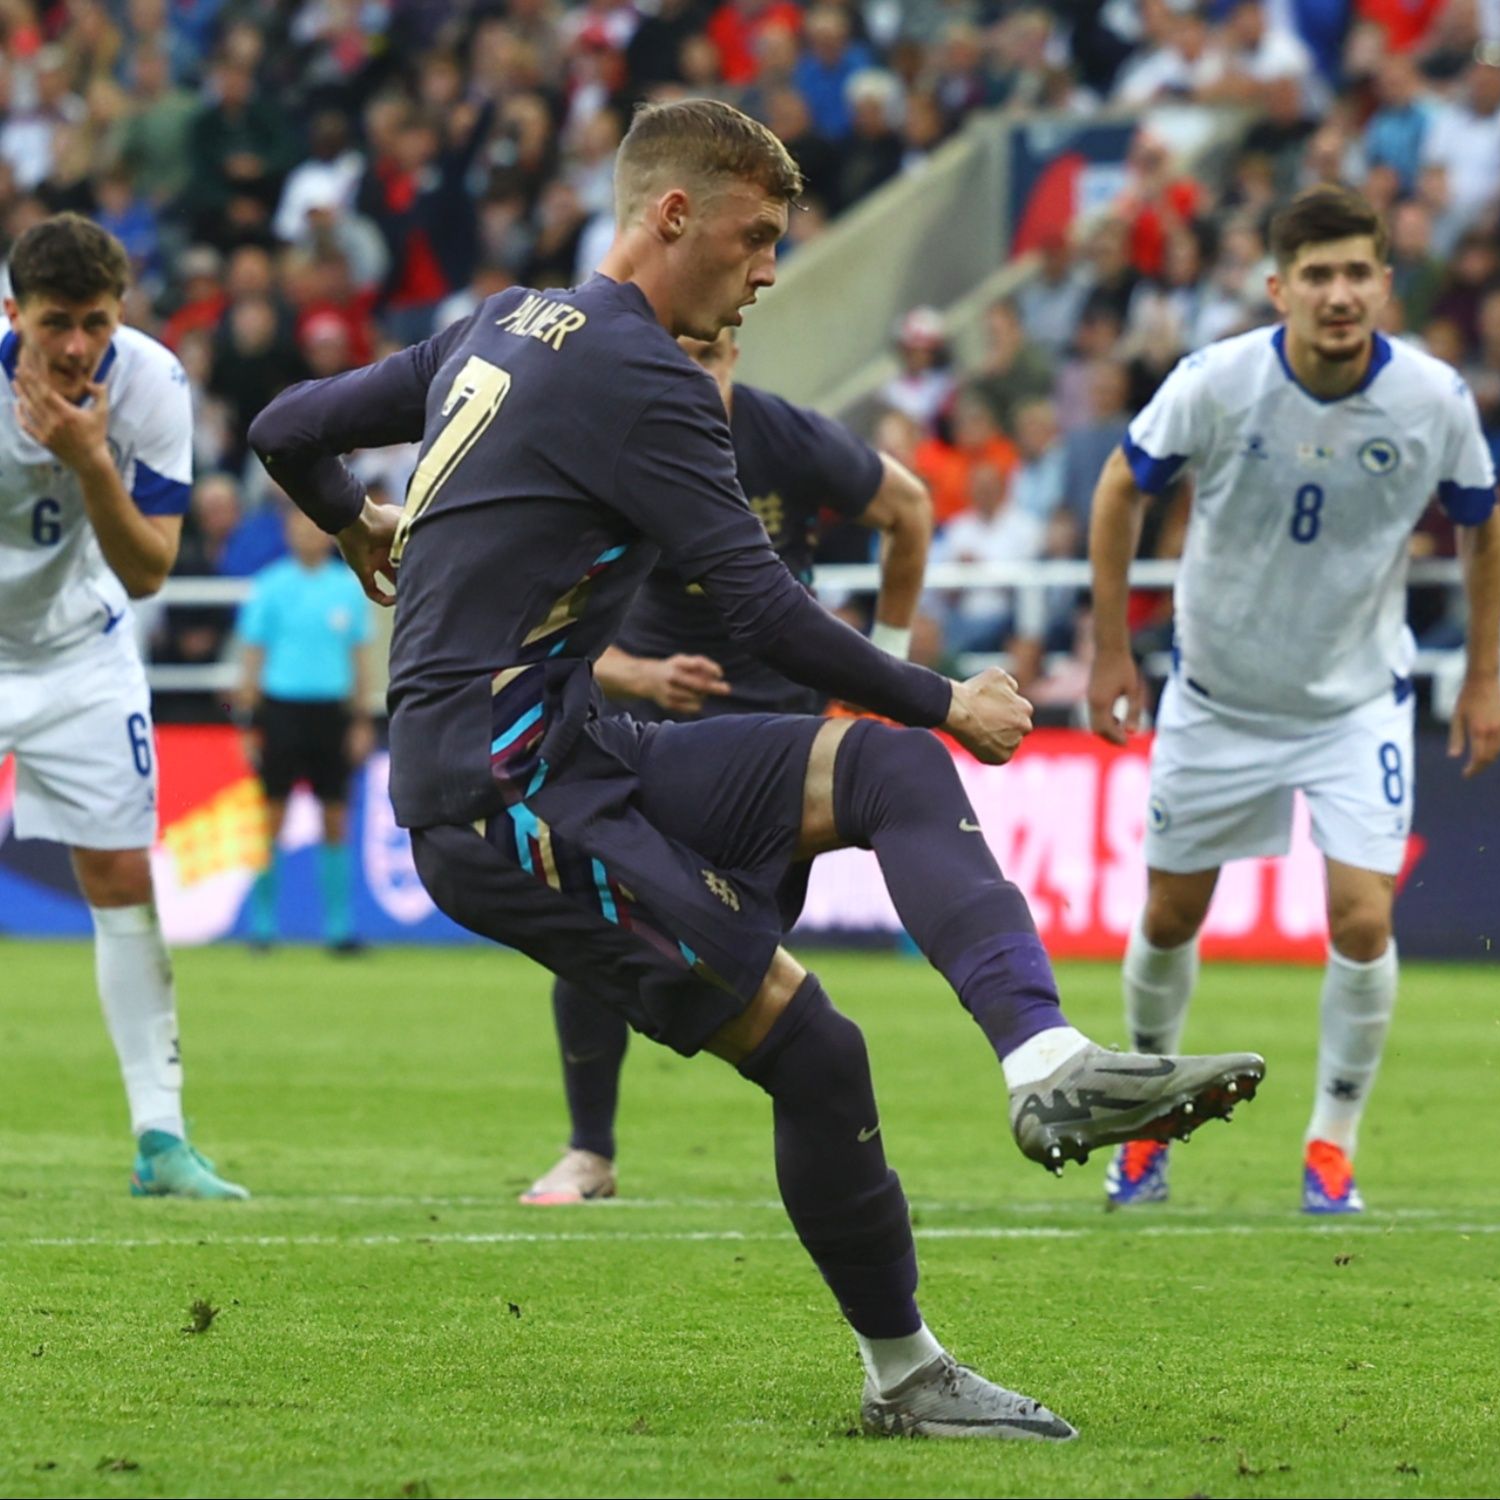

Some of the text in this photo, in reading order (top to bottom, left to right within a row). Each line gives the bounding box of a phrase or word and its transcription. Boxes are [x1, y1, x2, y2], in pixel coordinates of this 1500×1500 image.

[388, 355, 511, 568] 7
[31, 497, 61, 546] 6
[1290, 483, 1324, 544] 8
[127, 712, 151, 778] 6
[1379, 742, 1404, 805] 8
